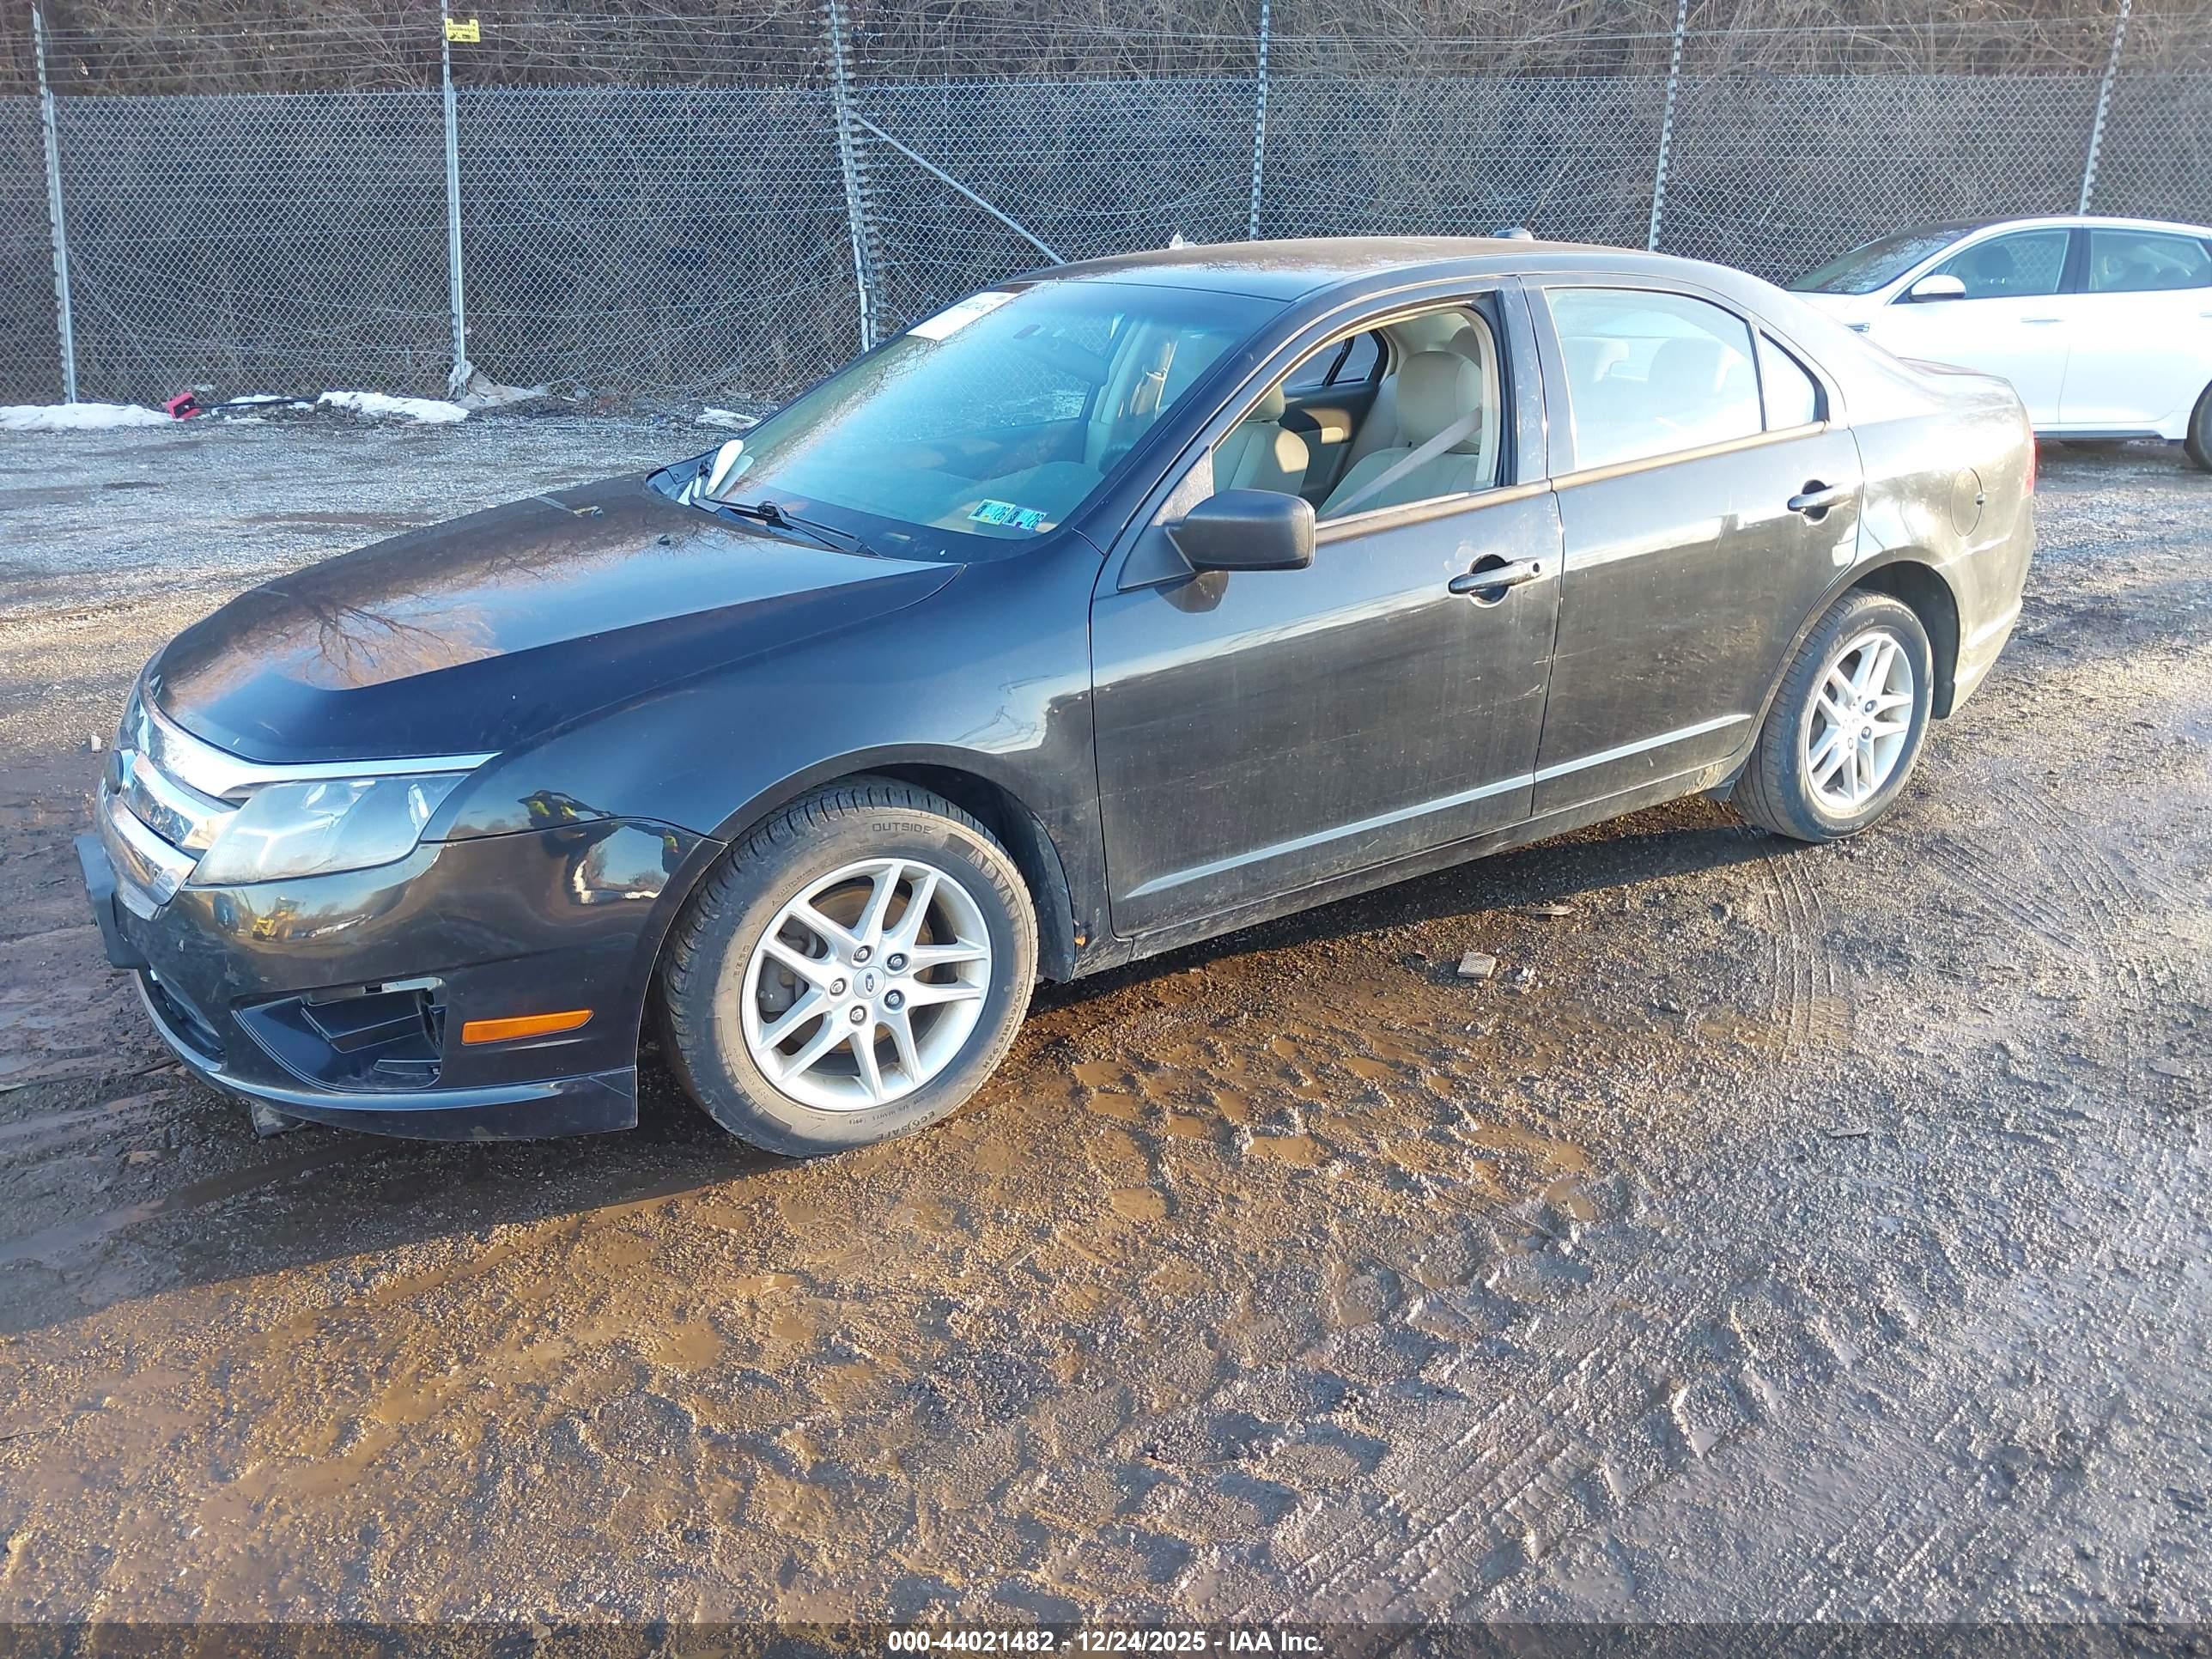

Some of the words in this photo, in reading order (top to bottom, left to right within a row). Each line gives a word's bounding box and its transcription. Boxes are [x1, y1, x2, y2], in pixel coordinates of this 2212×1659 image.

[872, 822, 933, 835] OUTSIDE
[998, 981, 1024, 1044] 205/60R16
[981, 1047, 1000, 1068] 92H
